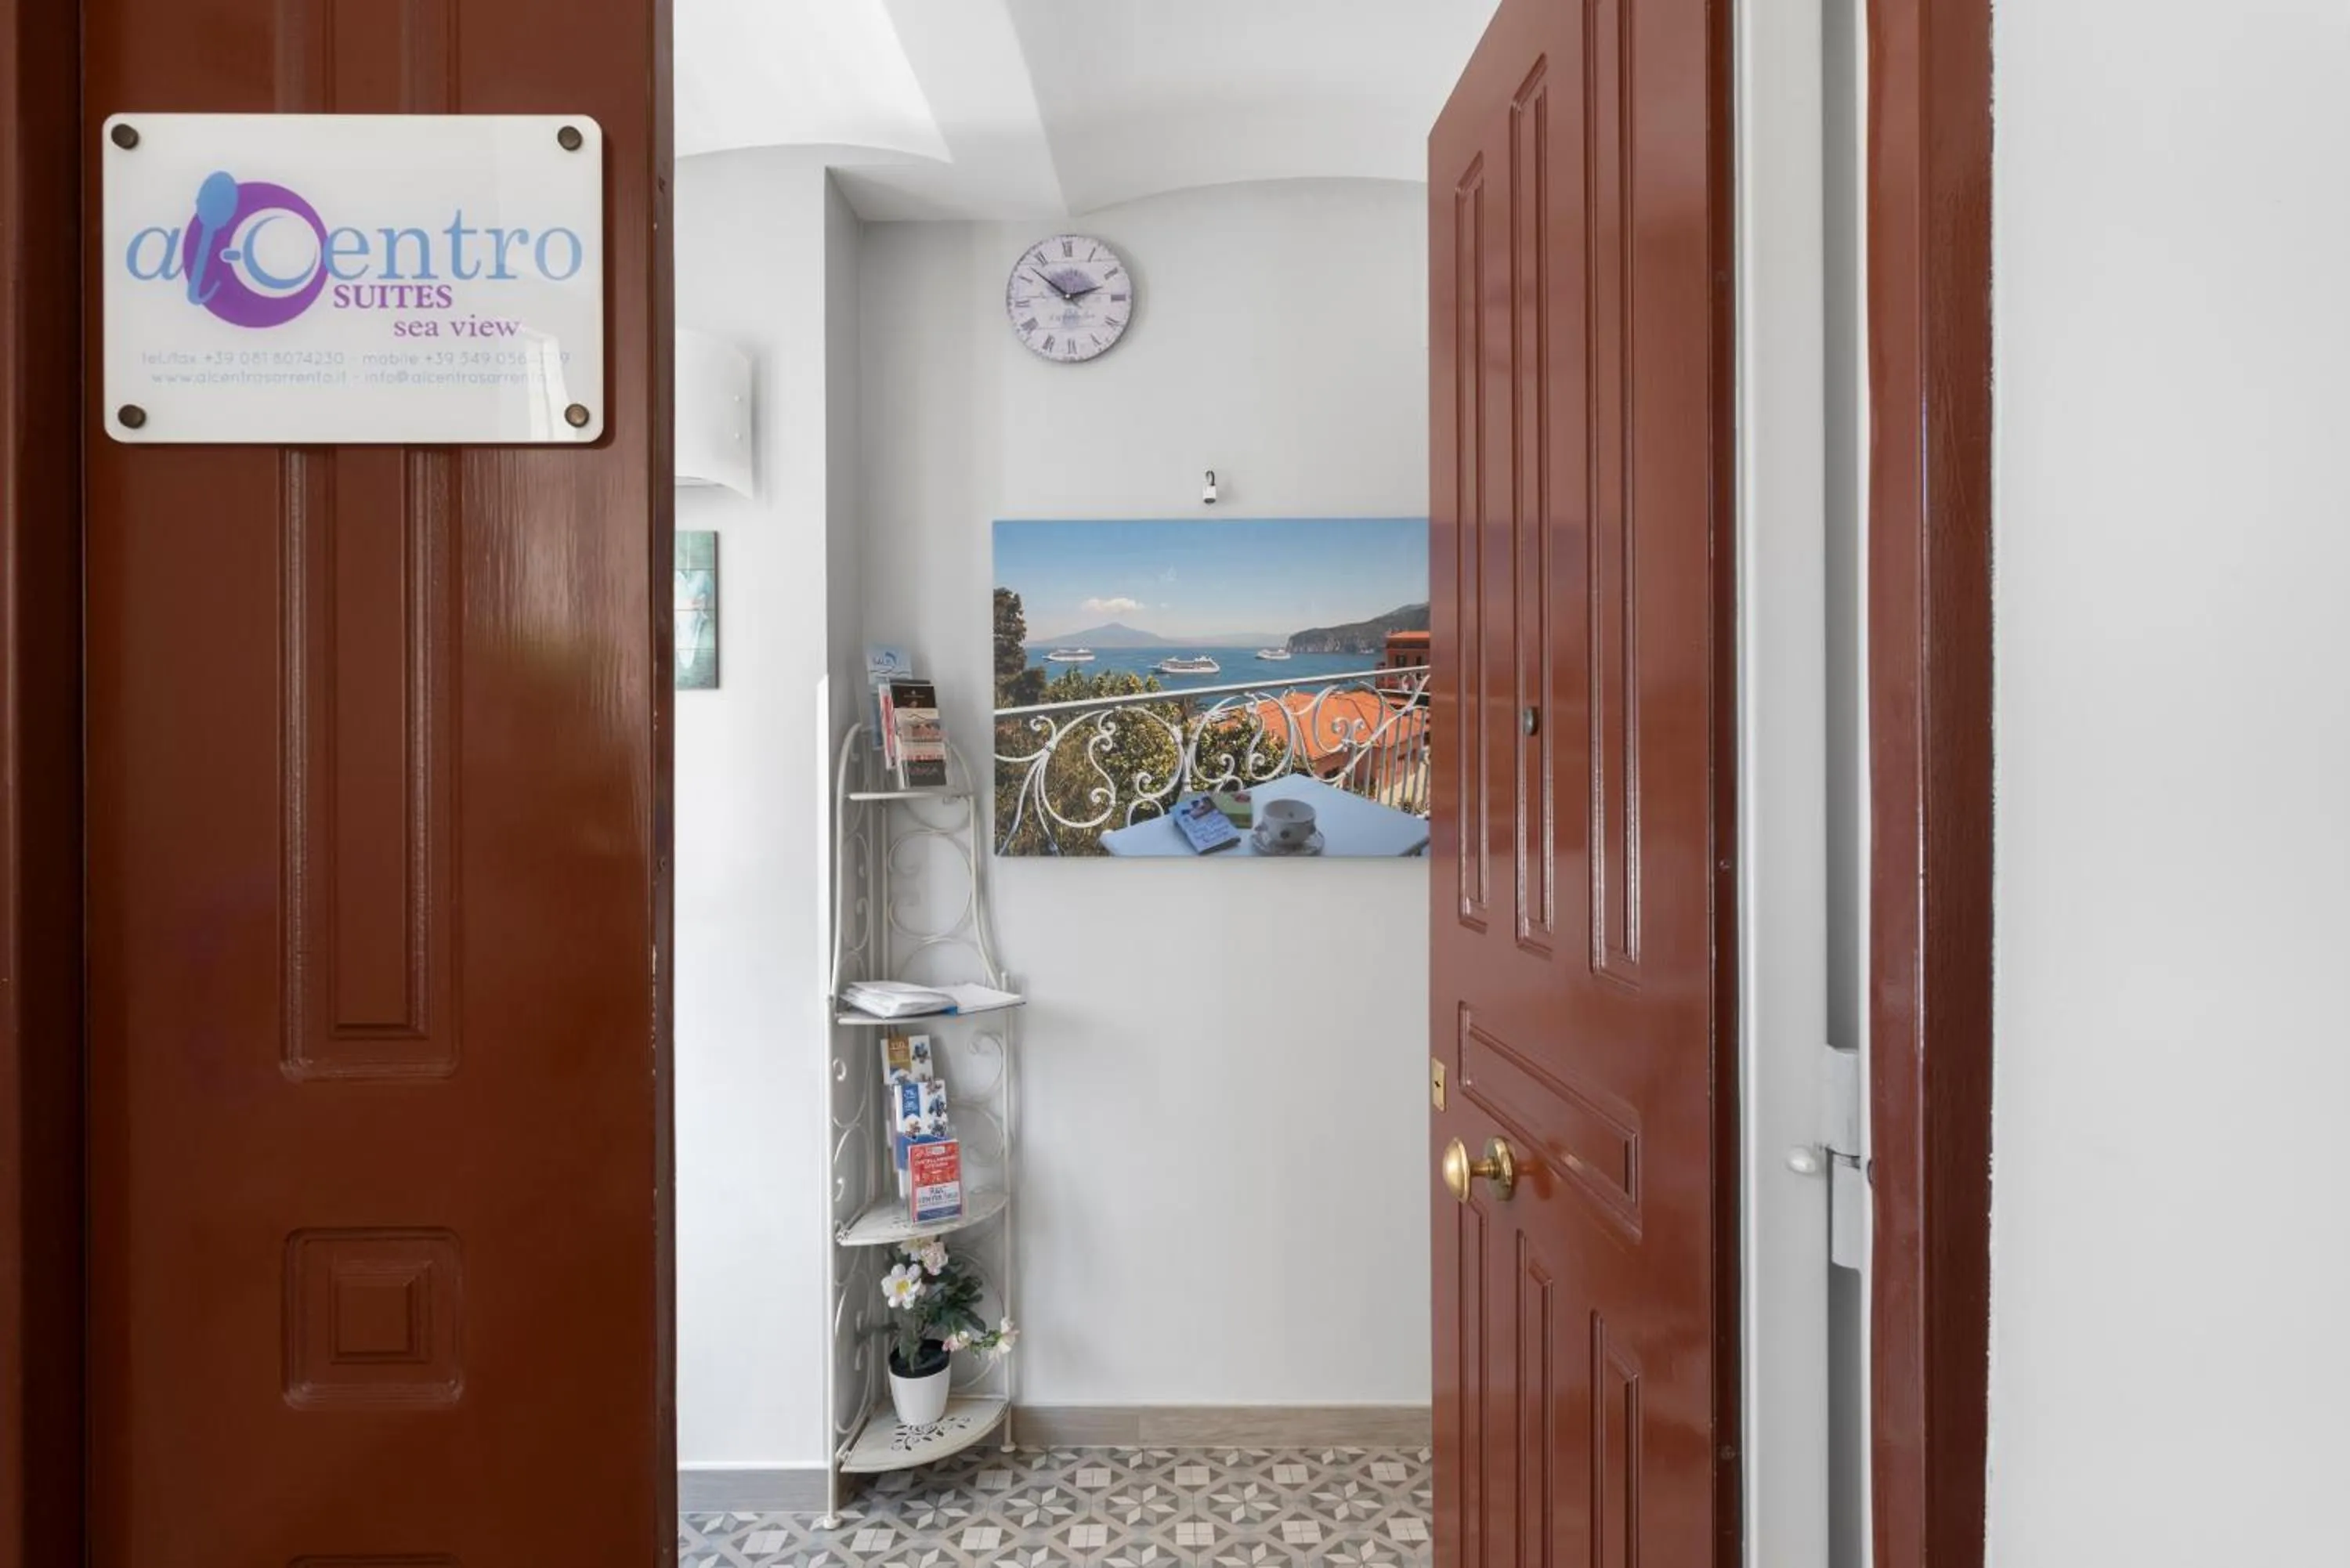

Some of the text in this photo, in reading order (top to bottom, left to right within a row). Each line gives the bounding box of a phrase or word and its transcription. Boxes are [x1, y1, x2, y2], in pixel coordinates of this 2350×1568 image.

[333, 284, 453, 309] SUITES
[393, 314, 521, 338] sea view
[362, 351, 419, 366] mobile
